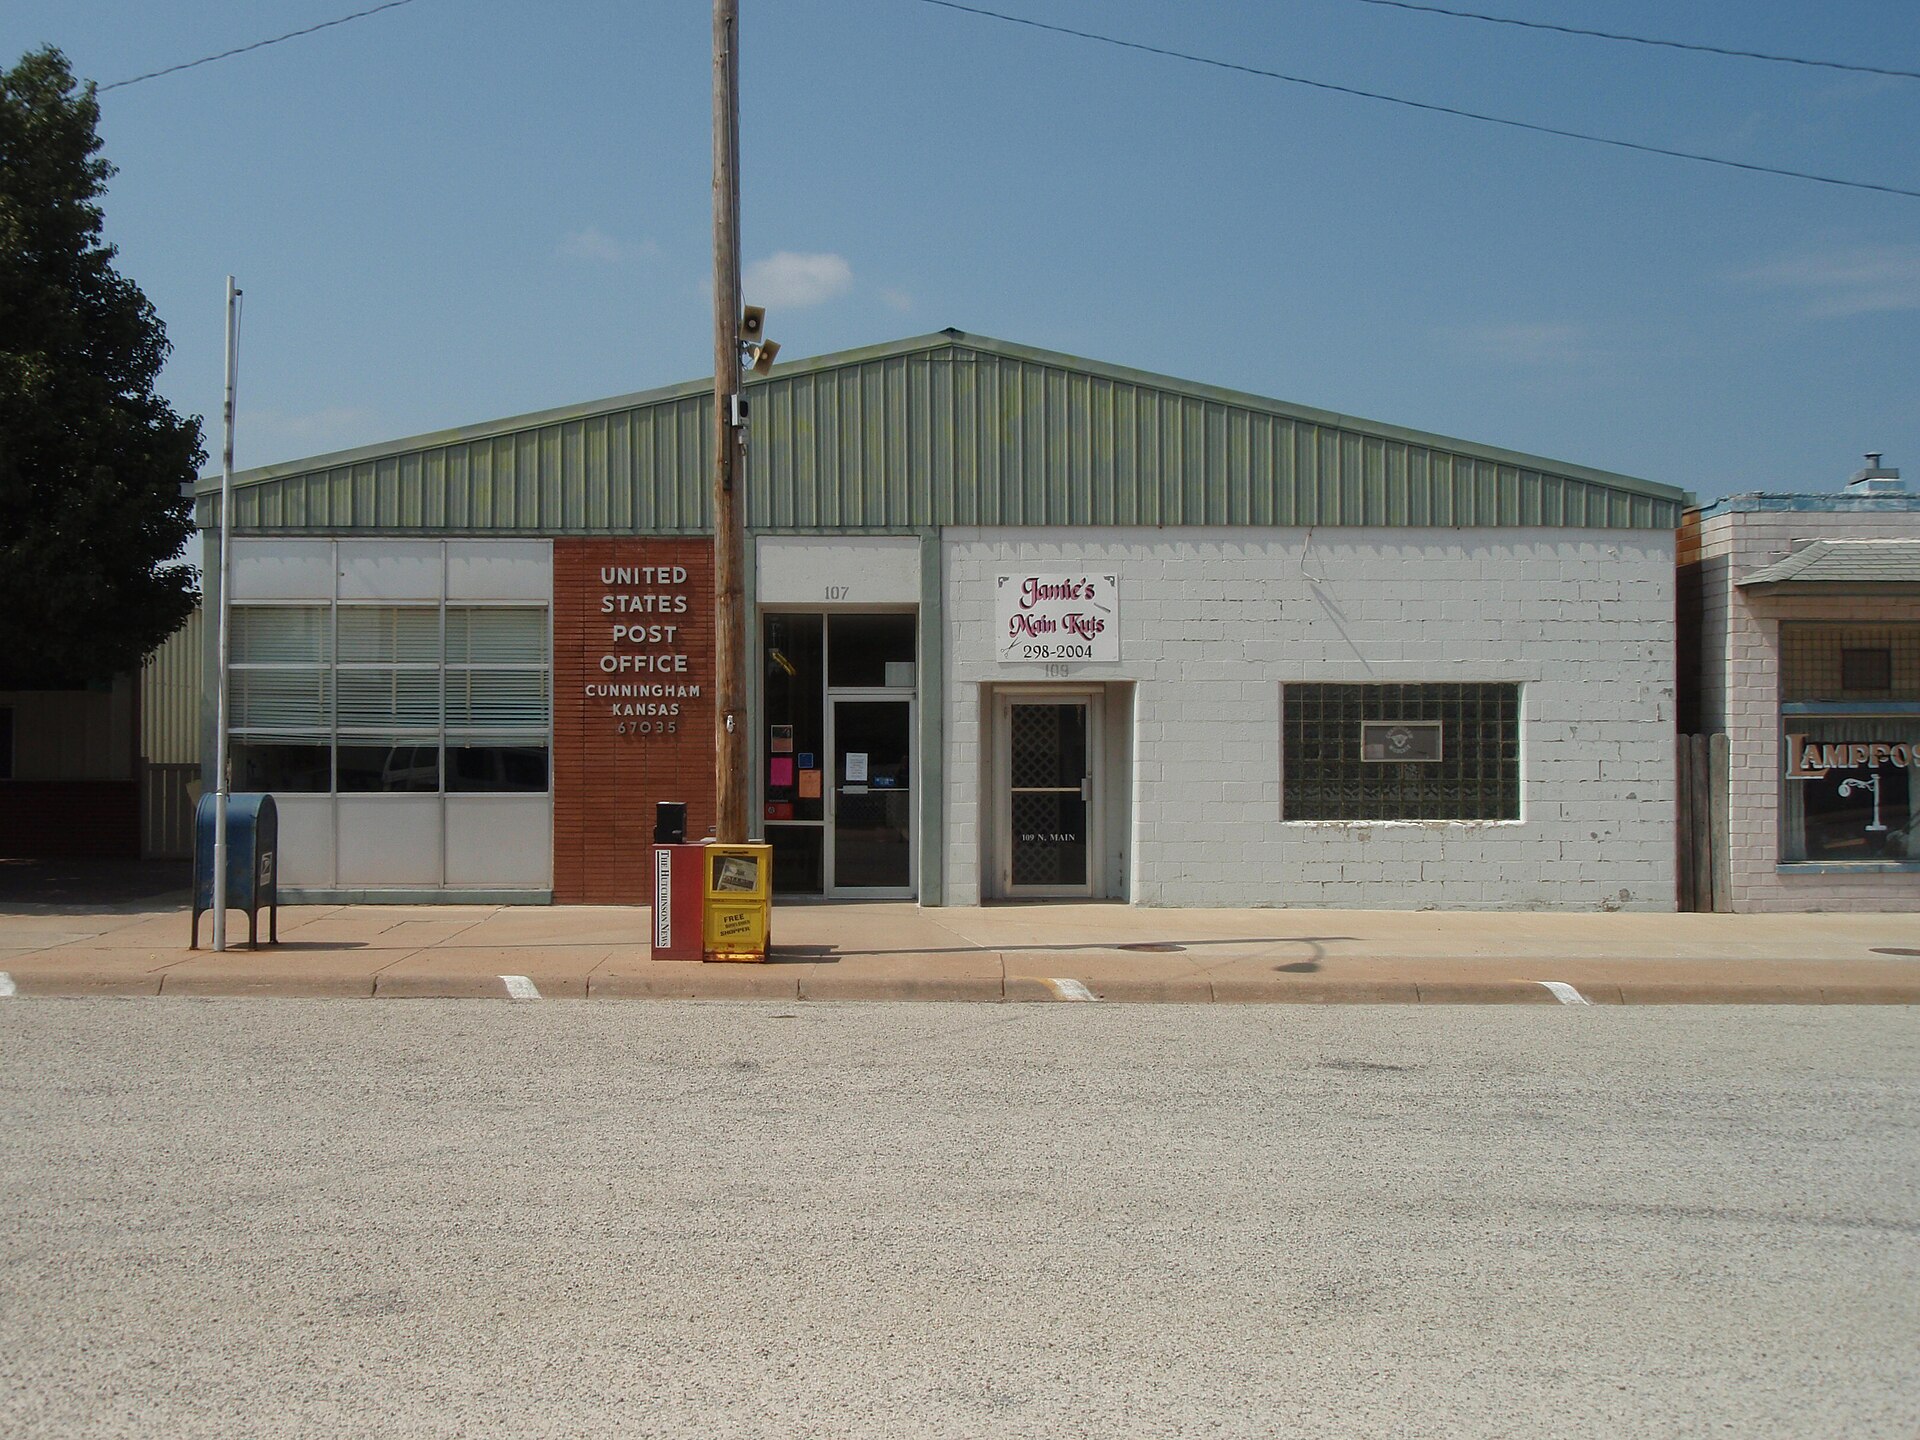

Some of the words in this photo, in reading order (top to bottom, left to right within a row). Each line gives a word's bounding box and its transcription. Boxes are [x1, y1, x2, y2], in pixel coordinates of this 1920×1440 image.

[601, 567, 687, 584] UNITED
[824, 586, 849, 600] 107
[1019, 577, 1095, 609] Jamie's
[601, 595, 687, 613] STATES
[613, 625, 677, 643] POST
[1009, 613, 1057, 638] Main
[1061, 613, 1105, 641] Kuts
[1023, 645, 1092, 658] 298-2004
[600, 655, 688, 673] OFFICE
[585, 684, 700, 697] CUNNINGHAM
[612, 703, 679, 716] KANSAS
[617, 721, 676, 734] 67035
[660, 851, 669, 868] THE
[660, 869, 669, 924] HUTCHINSON
[723, 913, 744, 923] FREE
[660, 924, 669, 947] NEWS
[720, 926, 750, 936] SHOPPER
